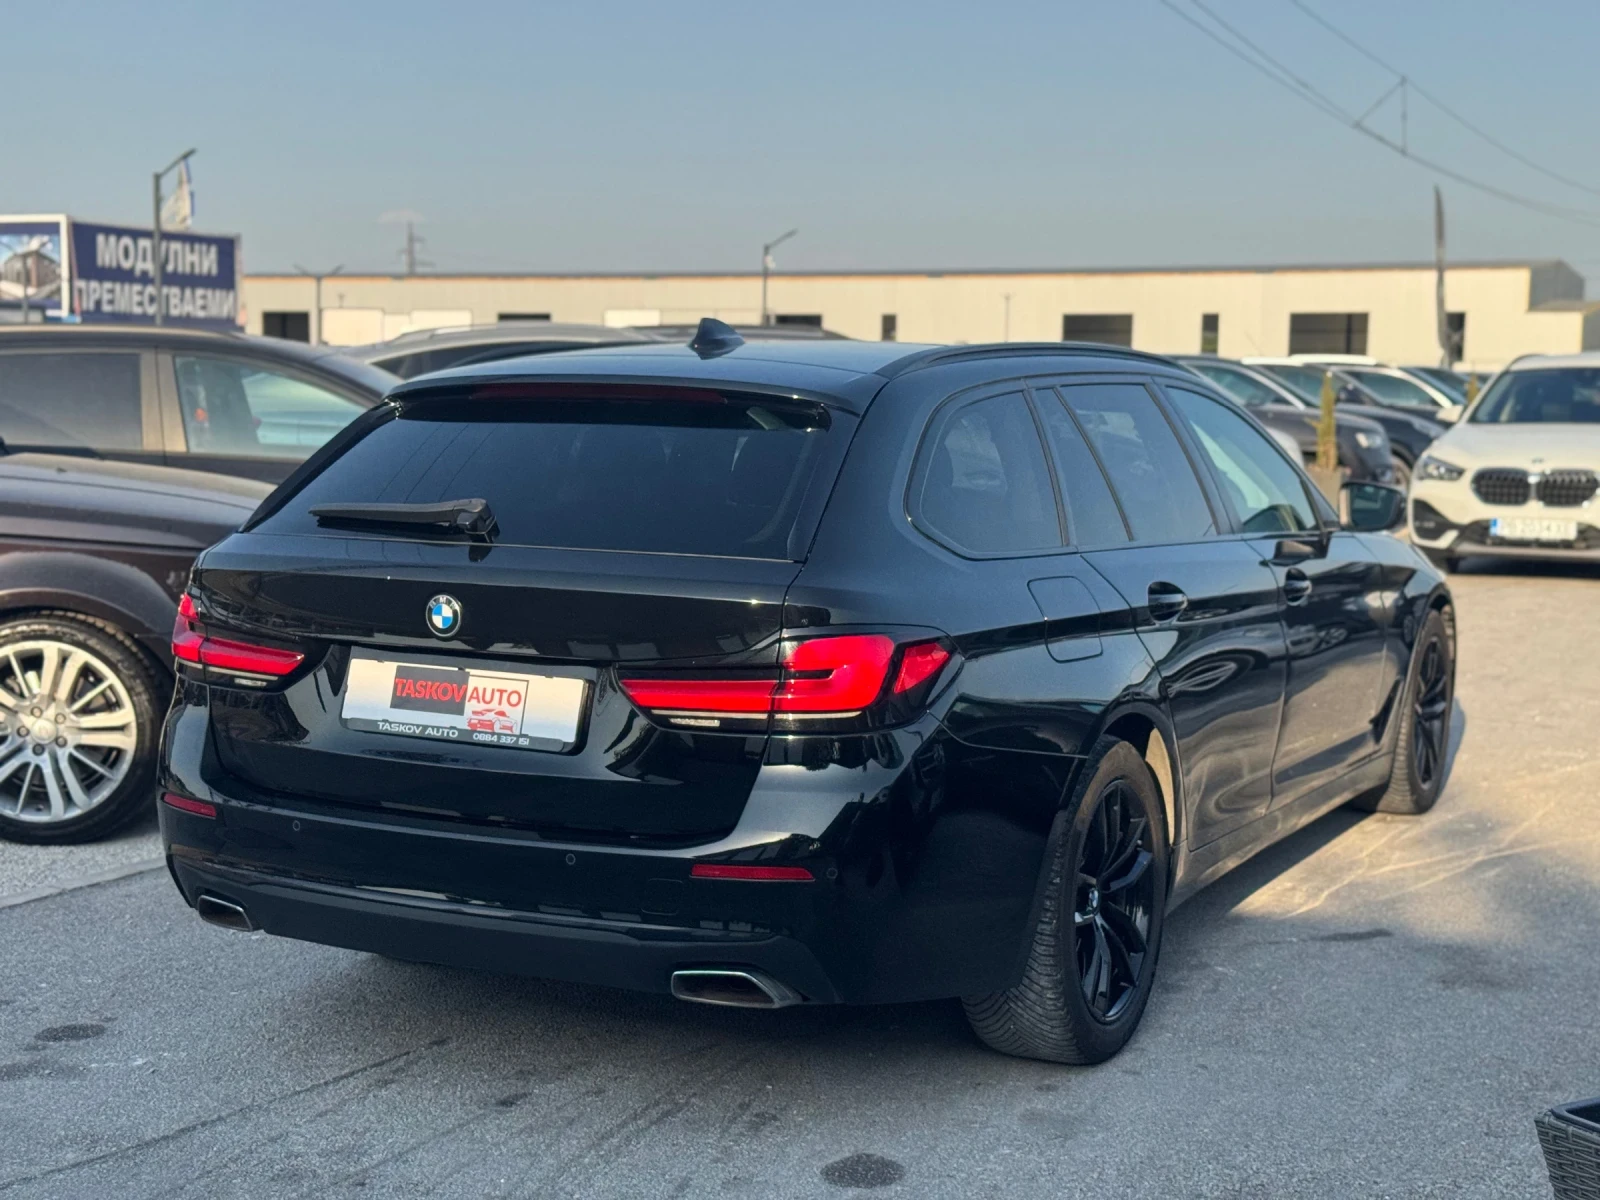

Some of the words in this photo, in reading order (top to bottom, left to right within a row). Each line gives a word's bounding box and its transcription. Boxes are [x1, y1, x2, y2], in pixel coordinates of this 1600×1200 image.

[395, 677, 467, 703] TASKOV
[468, 686, 522, 708] AUTO
[377, 721, 422, 734] TASKOV
[425, 726, 459, 738] AUTO
[473, 732, 497, 742] 0884
[499, 735, 516, 744] 337
